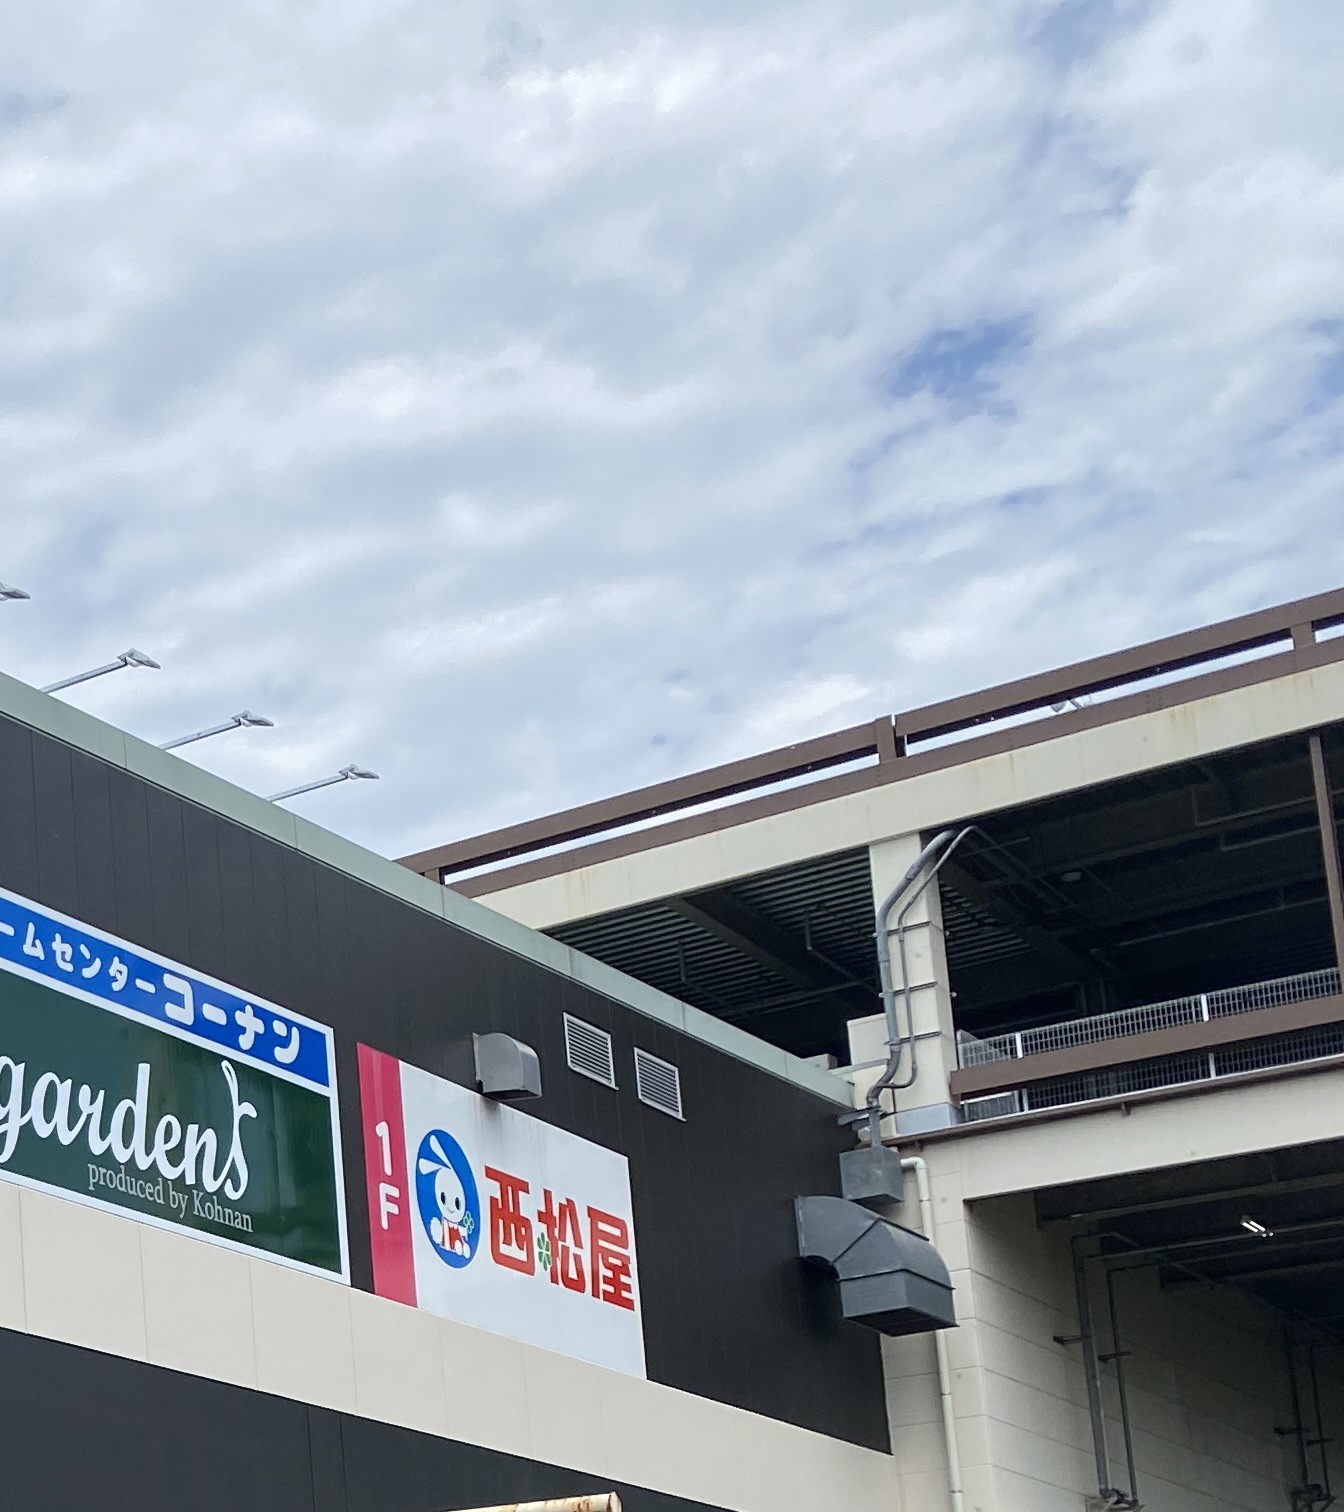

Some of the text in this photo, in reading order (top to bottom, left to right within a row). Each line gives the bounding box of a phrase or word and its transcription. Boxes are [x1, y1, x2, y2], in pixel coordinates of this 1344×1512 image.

[87, 1164, 254, 1233] produced by Kohnan
[375, 1120, 400, 1230] 1F
[484, 1165, 635, 1312] 西松屋
